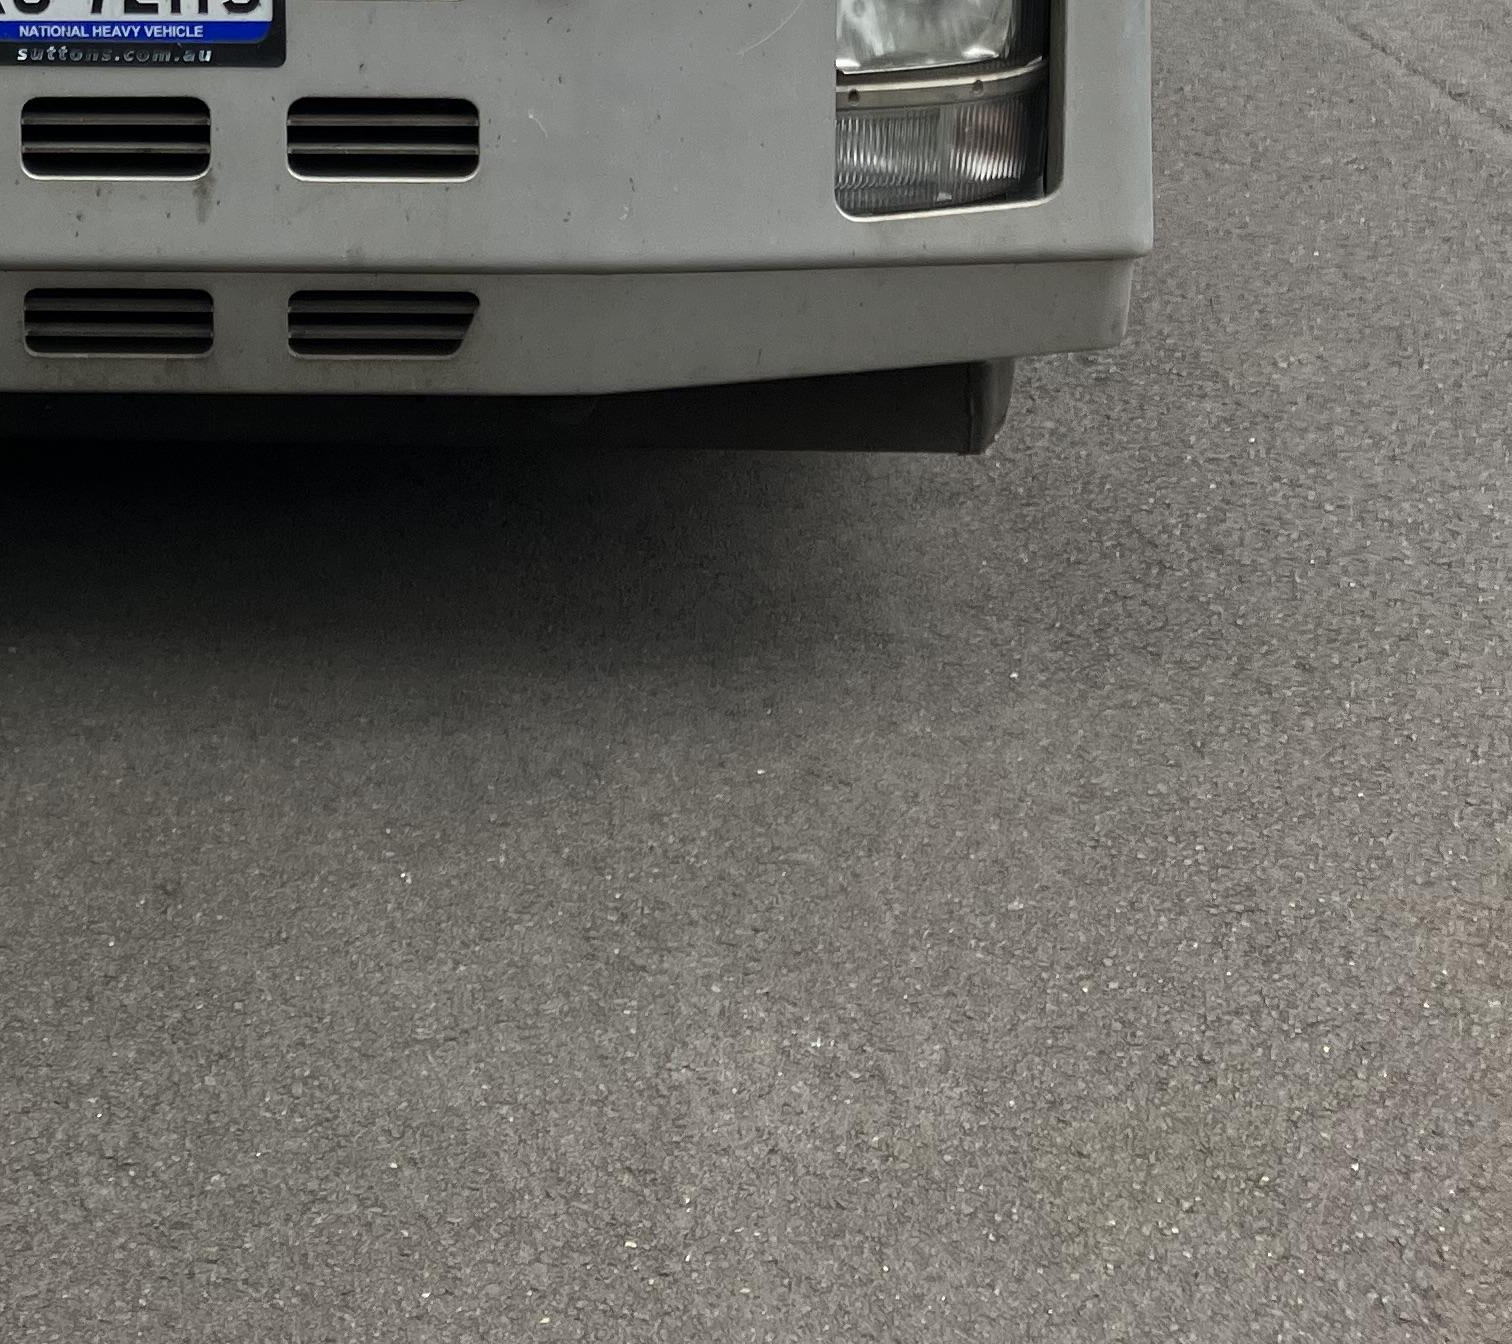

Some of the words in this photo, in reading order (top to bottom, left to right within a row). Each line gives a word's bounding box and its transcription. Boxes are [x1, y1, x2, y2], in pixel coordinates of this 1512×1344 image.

[19, 25, 89, 38] NATIONAL
[92, 25, 141, 38] HEAVY
[144, 25, 204, 38] VEHICLE
[16, 45, 213, 63] suttons.com.au
